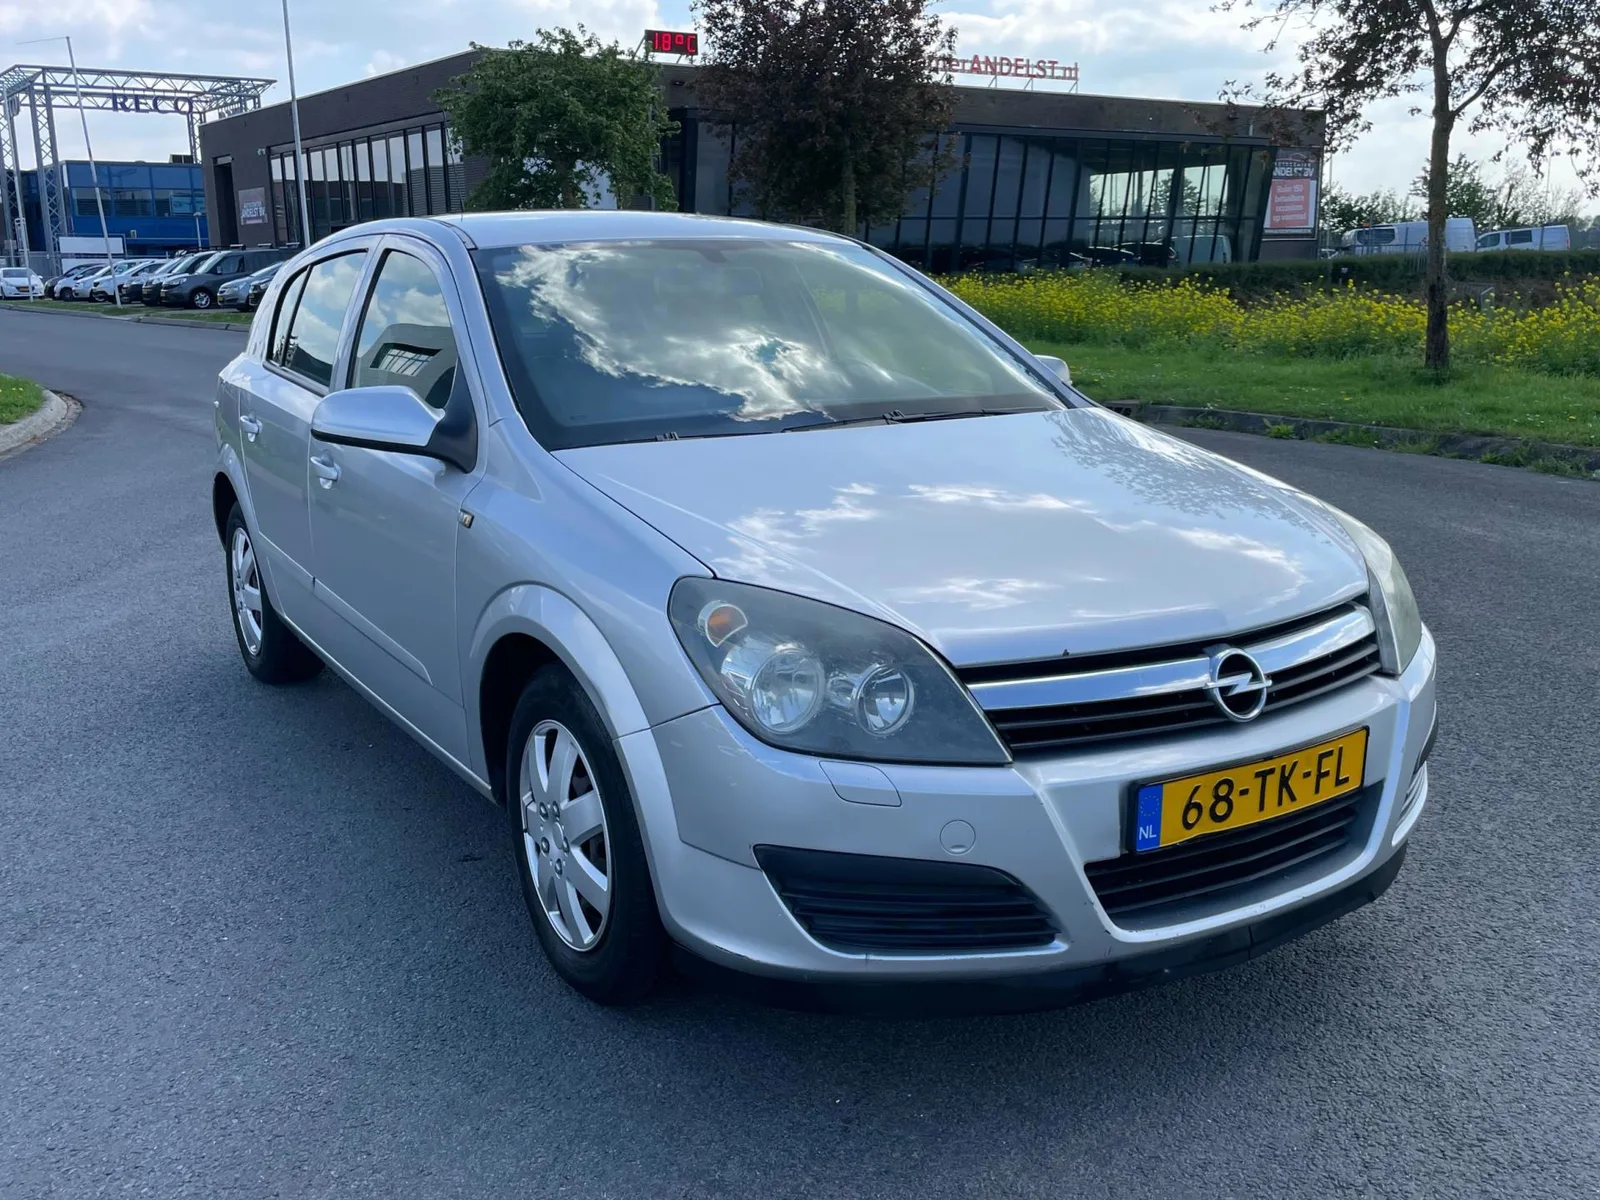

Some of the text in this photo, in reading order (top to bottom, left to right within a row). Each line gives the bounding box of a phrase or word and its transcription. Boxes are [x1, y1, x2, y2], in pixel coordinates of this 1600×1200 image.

[112, 93, 194, 115] RECO
[1181, 746, 1350, 830] 68-TK-FL
[1138, 826, 1157, 840] NL
